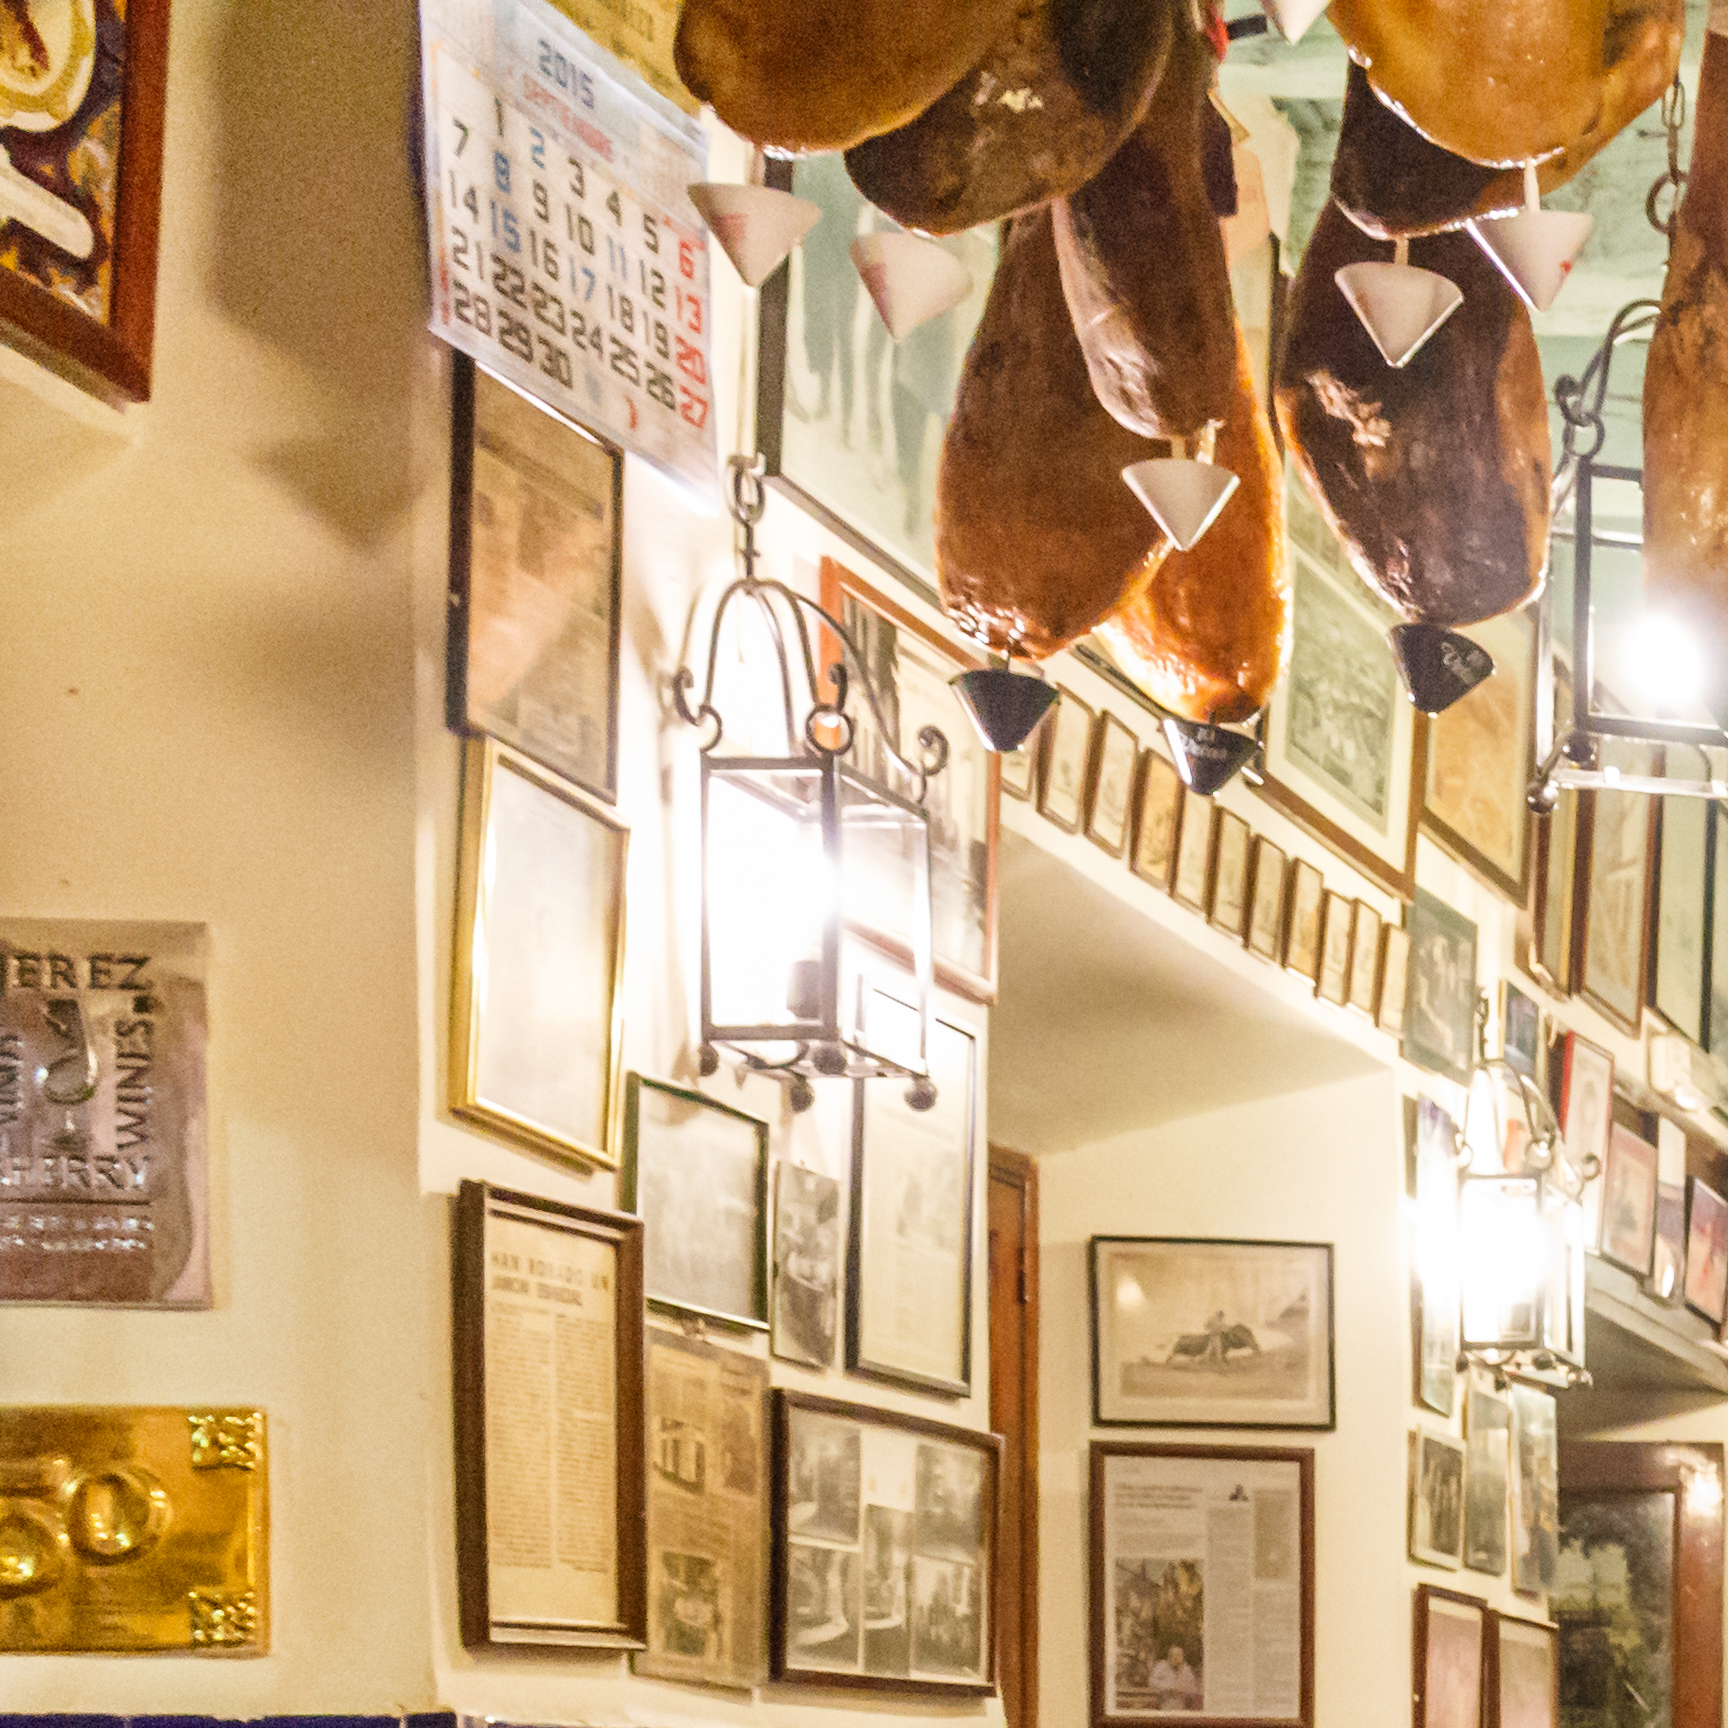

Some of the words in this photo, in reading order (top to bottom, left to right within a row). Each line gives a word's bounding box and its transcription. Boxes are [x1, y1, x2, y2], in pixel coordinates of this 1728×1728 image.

[537, 37, 595, 110] 2015
[453, 116, 469, 158] 7
[494, 150, 512, 194] 8
[533, 179, 550, 224] 9
[566, 203, 596, 257] 10
[607, 233, 628, 280] 11
[640, 258, 668, 311] 12
[675, 285, 703, 335] 13
[494, 97, 505, 138] 1
[529, 127, 546, 171] 2
[568, 155, 585, 199] 3
[606, 190, 623, 227] 4
[643, 212, 659, 255] 5
[679, 239, 695, 280] 6
[449, 170, 480, 225] 14
[490, 199, 521, 254] 15
[530, 229, 560, 282] 16
[570, 256, 597, 301] 17
[607, 284, 635, 335] 18
[642, 310, 670, 360] 19
[451, 226, 485, 281] 21
[530, 281, 567, 337] 23
[570, 309, 604, 362] 24
[610, 333, 641, 388] 25
[453, 279, 493, 339] 28
[536, 333, 574, 391] 30
[0, 950, 153, 992] EREZ
[115, 1017, 154, 1152] WINES
[0, 1154, 151, 1190] HERRY
